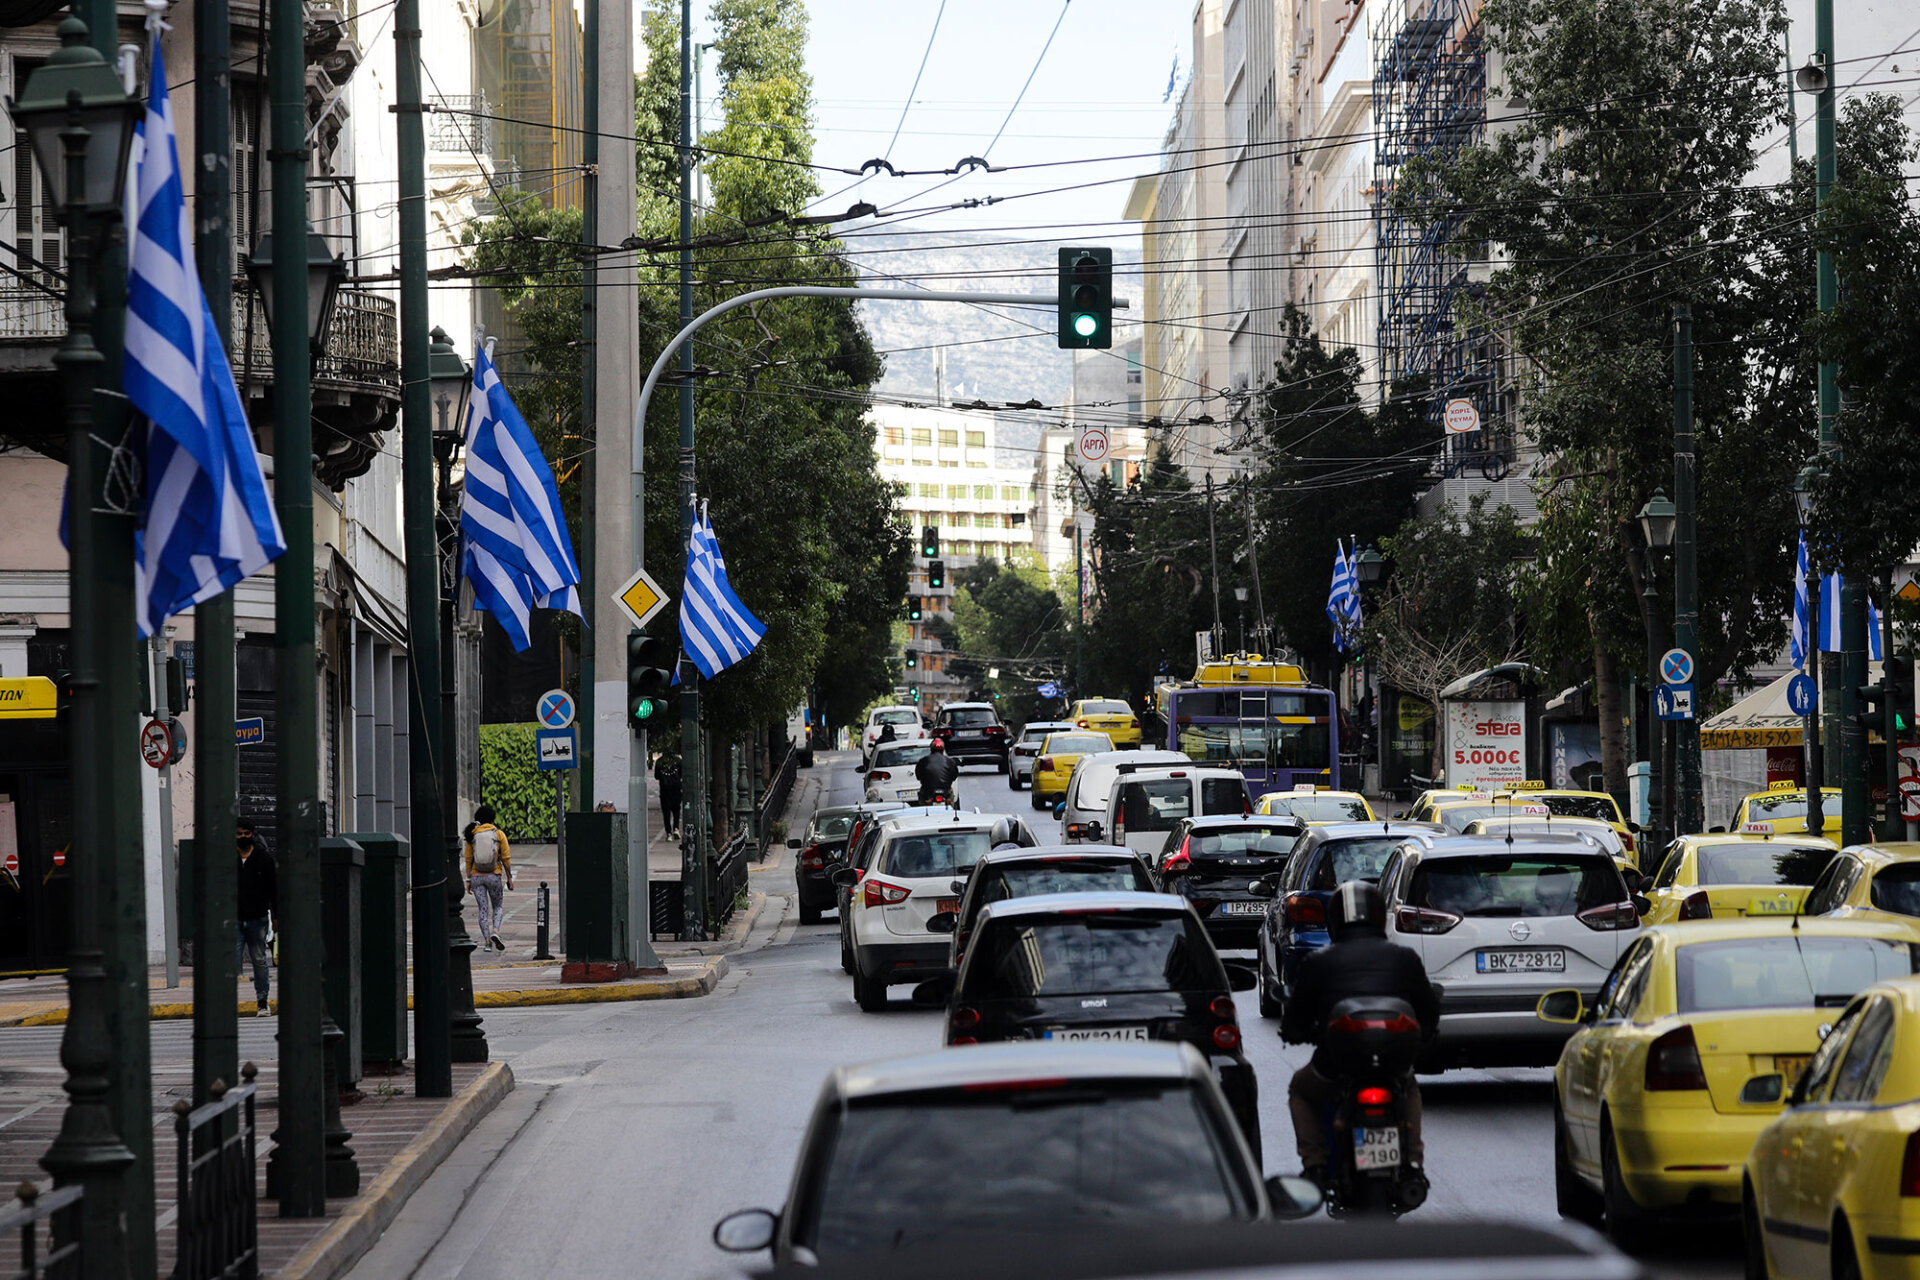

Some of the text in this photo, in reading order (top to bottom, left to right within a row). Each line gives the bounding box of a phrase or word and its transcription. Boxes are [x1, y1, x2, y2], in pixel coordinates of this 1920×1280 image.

[1449, 415, 1473, 423] ΡΕΥΜΑ
[1084, 439, 1105, 450] ΑΡΓΑ
[1475, 718, 1521, 736] sfera
[1455, 750, 1520, 765] 5.000€
[1746, 824, 1768, 832] TAXI
[1081, 998, 1108, 1008] smart
[1368, 1148, 1399, 1164] 190
